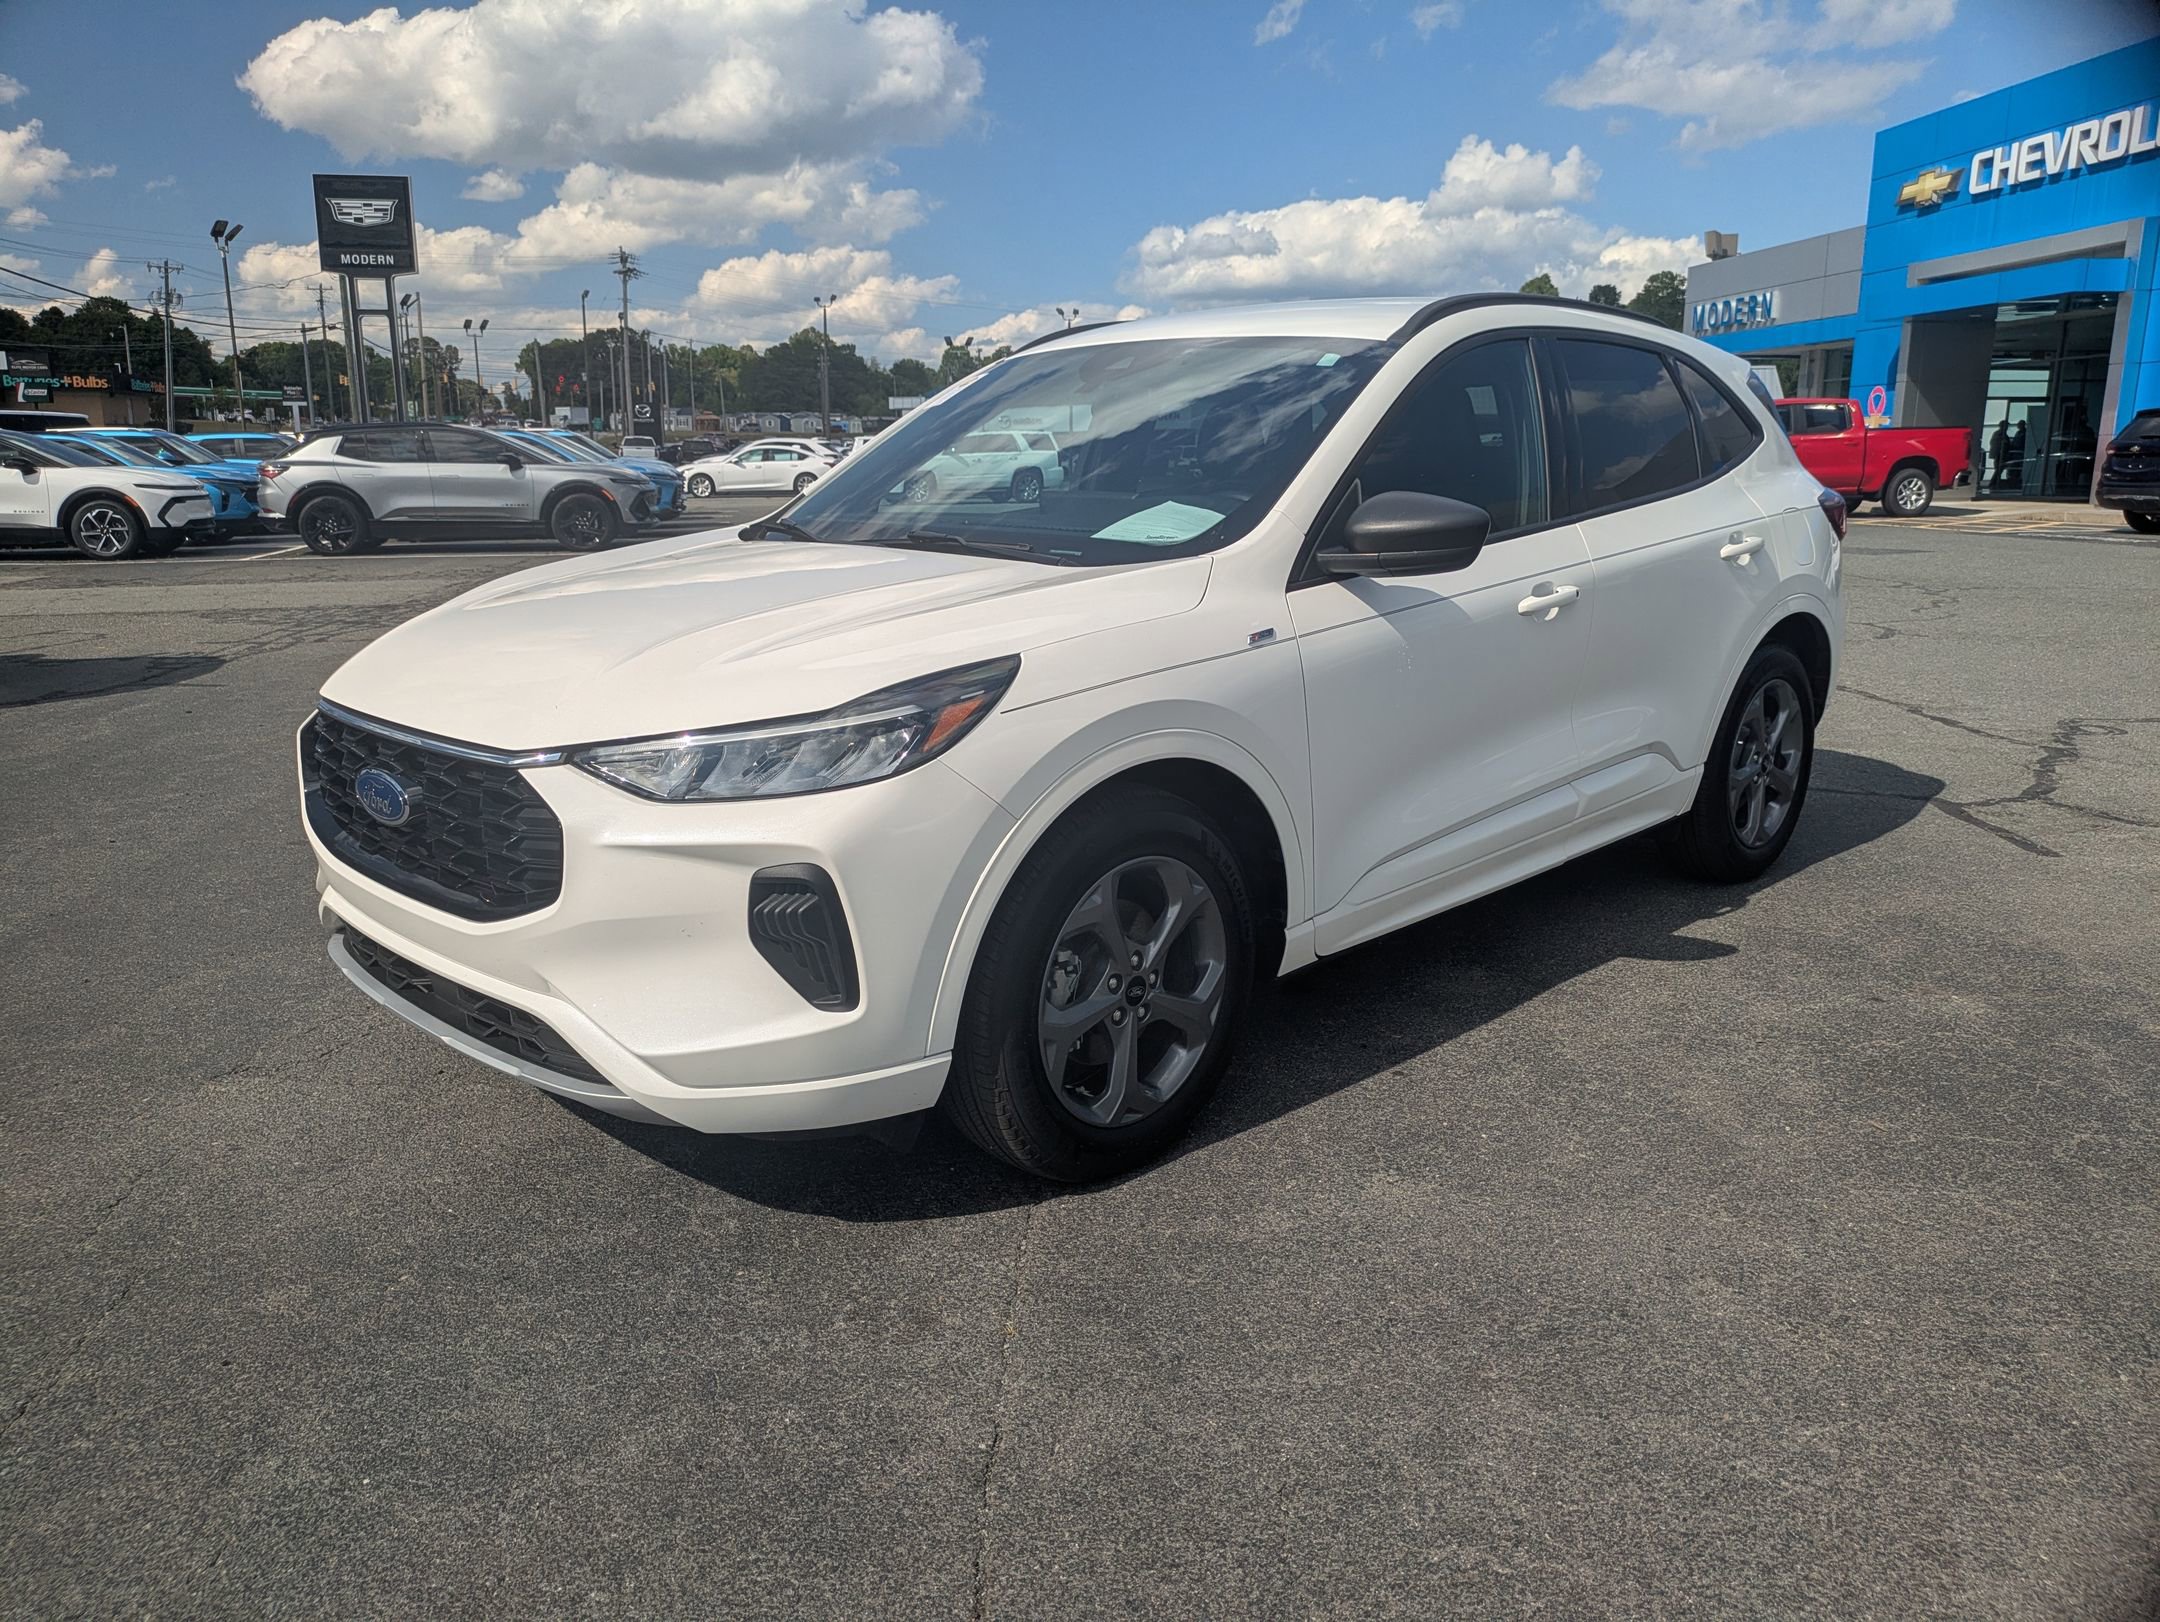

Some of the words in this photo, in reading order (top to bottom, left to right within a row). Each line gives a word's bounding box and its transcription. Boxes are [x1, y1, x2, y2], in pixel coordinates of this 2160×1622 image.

[1968, 104, 2160, 195] CHEVROL
[340, 254, 395, 265] MODERN
[1692, 290, 1774, 333] MODERN
